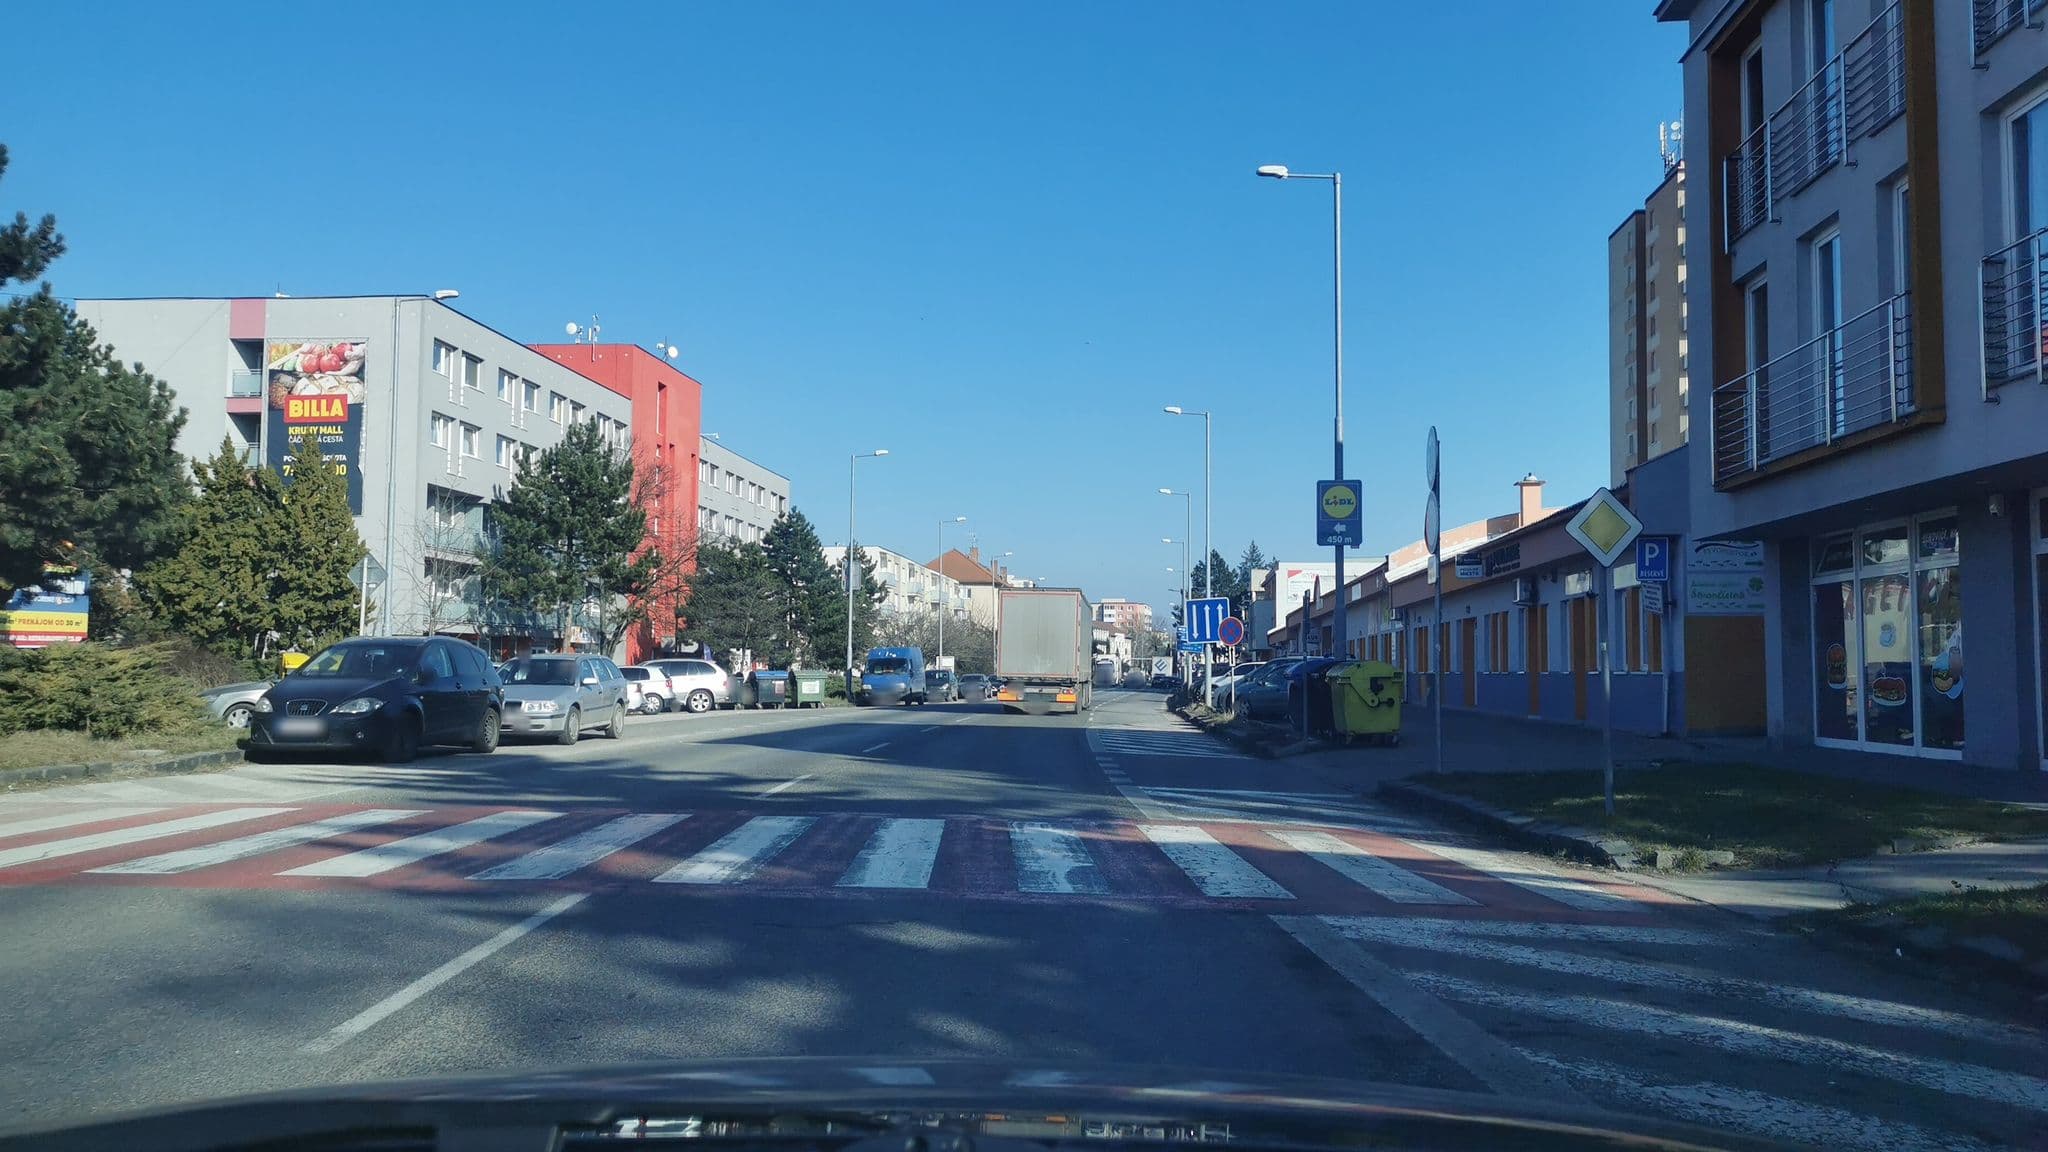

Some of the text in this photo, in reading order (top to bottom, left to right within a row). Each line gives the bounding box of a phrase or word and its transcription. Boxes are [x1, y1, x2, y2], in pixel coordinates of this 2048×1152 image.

[289, 399, 344, 417] BILLA
[319, 425, 343, 434] MALL
[1645, 543, 1659, 566] P
